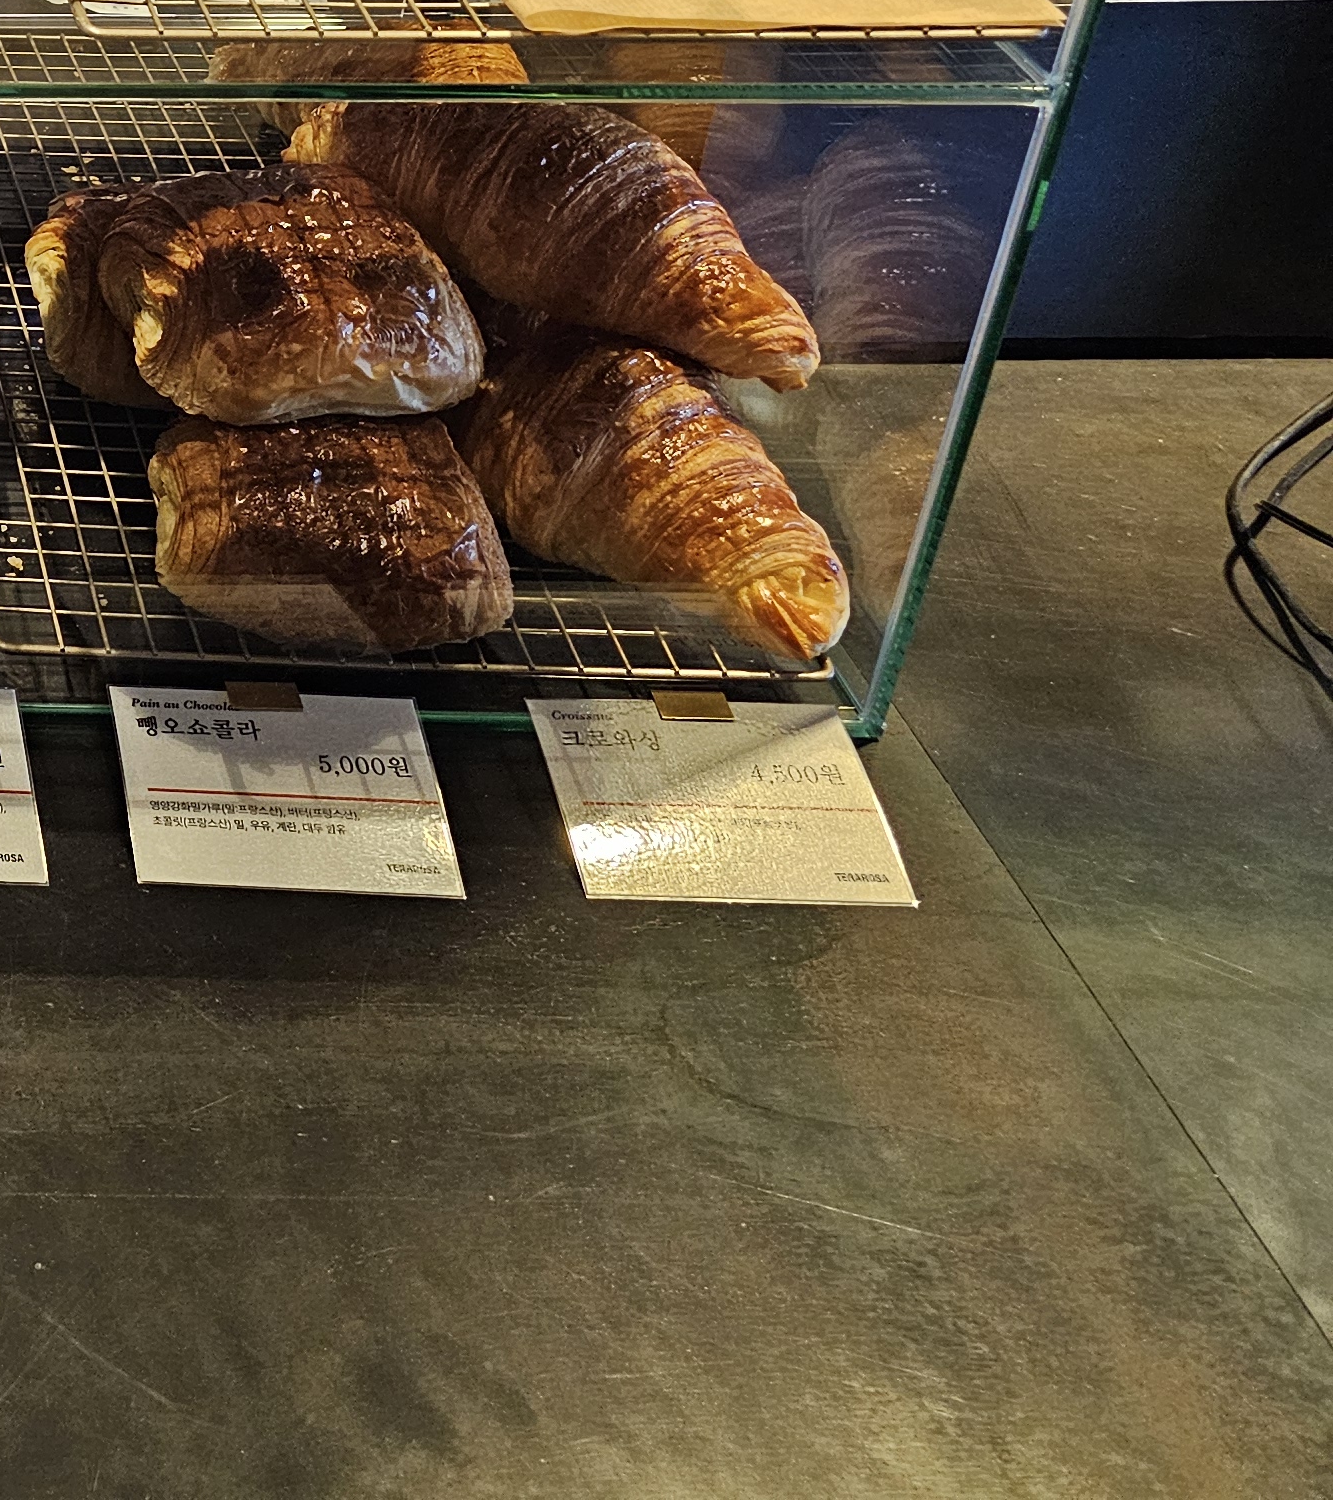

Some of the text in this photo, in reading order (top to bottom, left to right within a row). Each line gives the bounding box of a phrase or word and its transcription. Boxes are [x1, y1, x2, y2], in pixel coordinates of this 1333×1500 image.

[131, 697, 180, 709] Pain au
[137, 715, 261, 742] 뺑오쇼콜라
[561, 730, 662, 752] 크로와상
[318, 754, 413, 778] 5,000원
[750, 763, 846, 786] 4,500원
[833, 872, 890, 884] TERAROSA
